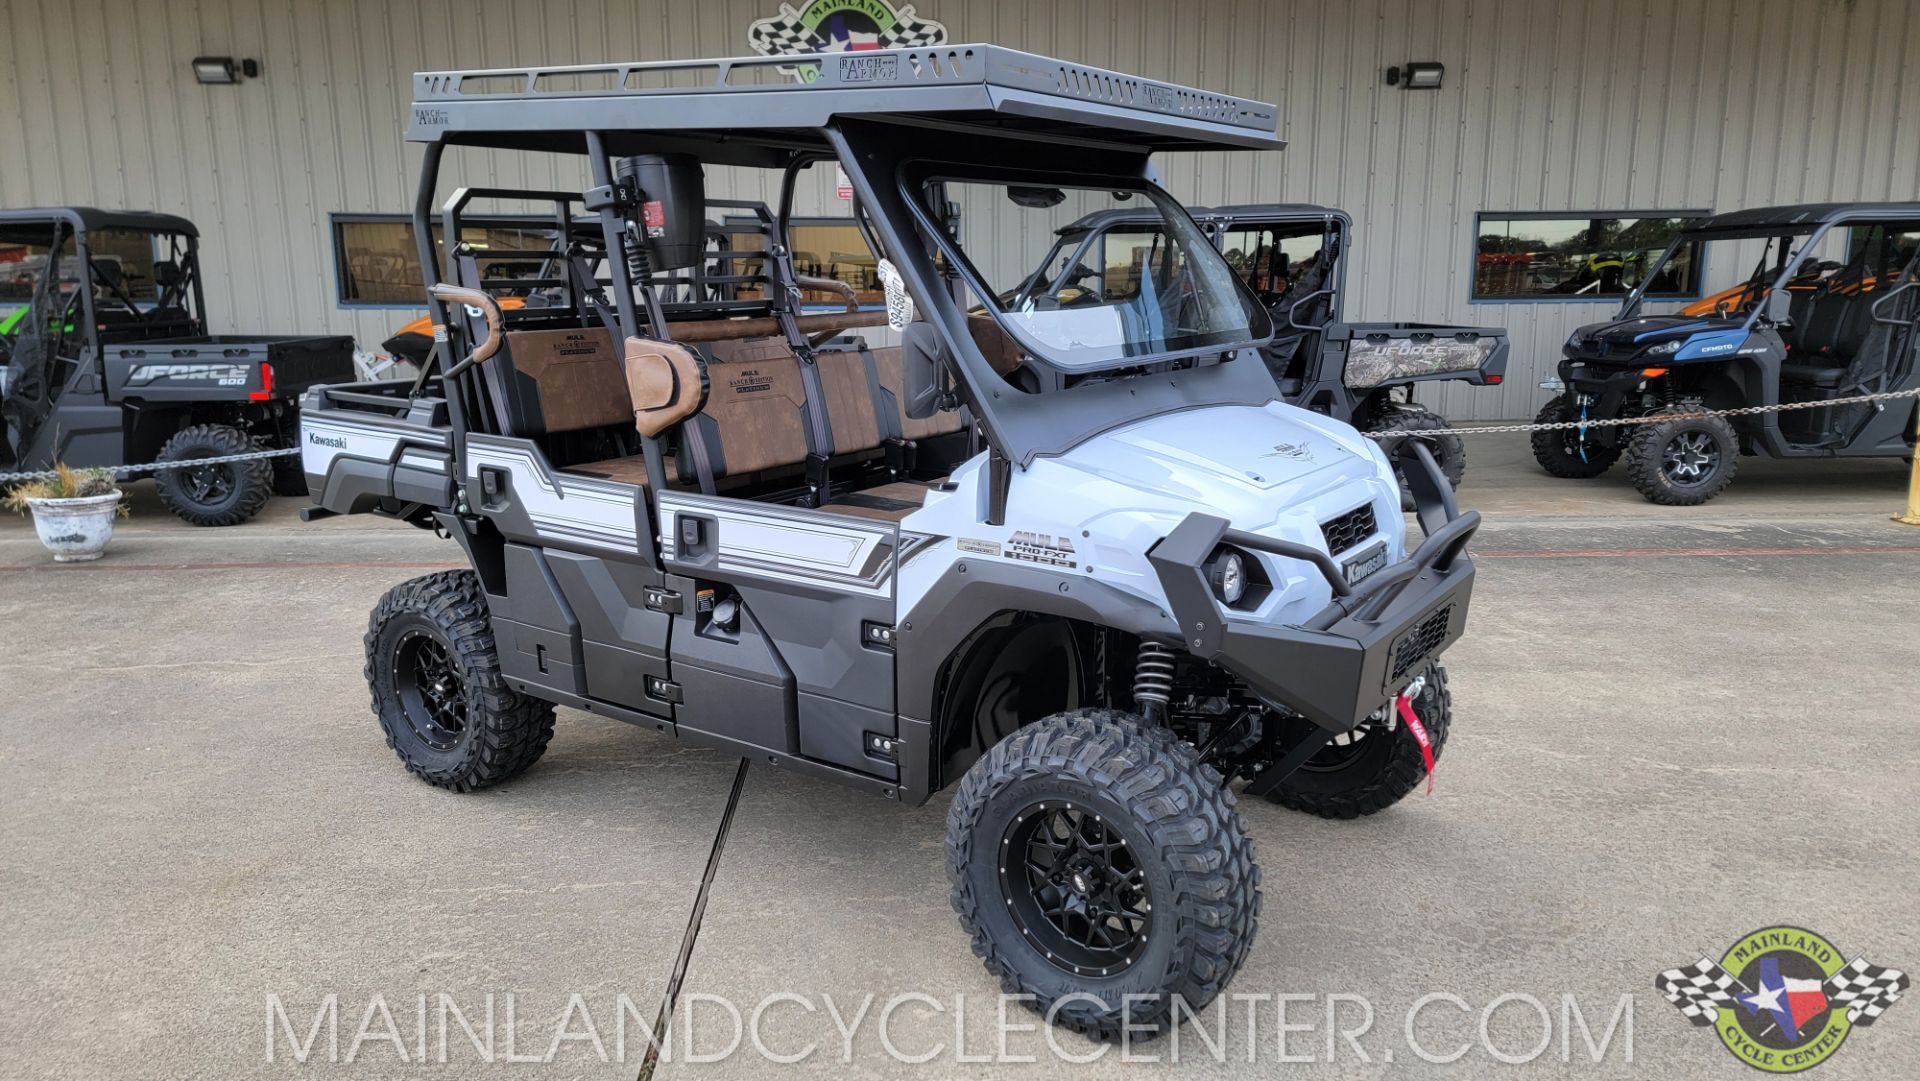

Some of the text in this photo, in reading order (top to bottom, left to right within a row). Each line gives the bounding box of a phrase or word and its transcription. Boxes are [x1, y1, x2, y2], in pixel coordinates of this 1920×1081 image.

[811, 0, 884, 20] MAINLAND
[842, 58, 882, 70] RANCH
[1374, 346, 1448, 356] UFORCE
[309, 431, 347, 449] Kawasaki
[1013, 545, 1069, 559] PRO-FXT
[1346, 545, 1387, 585] Kawasaki
